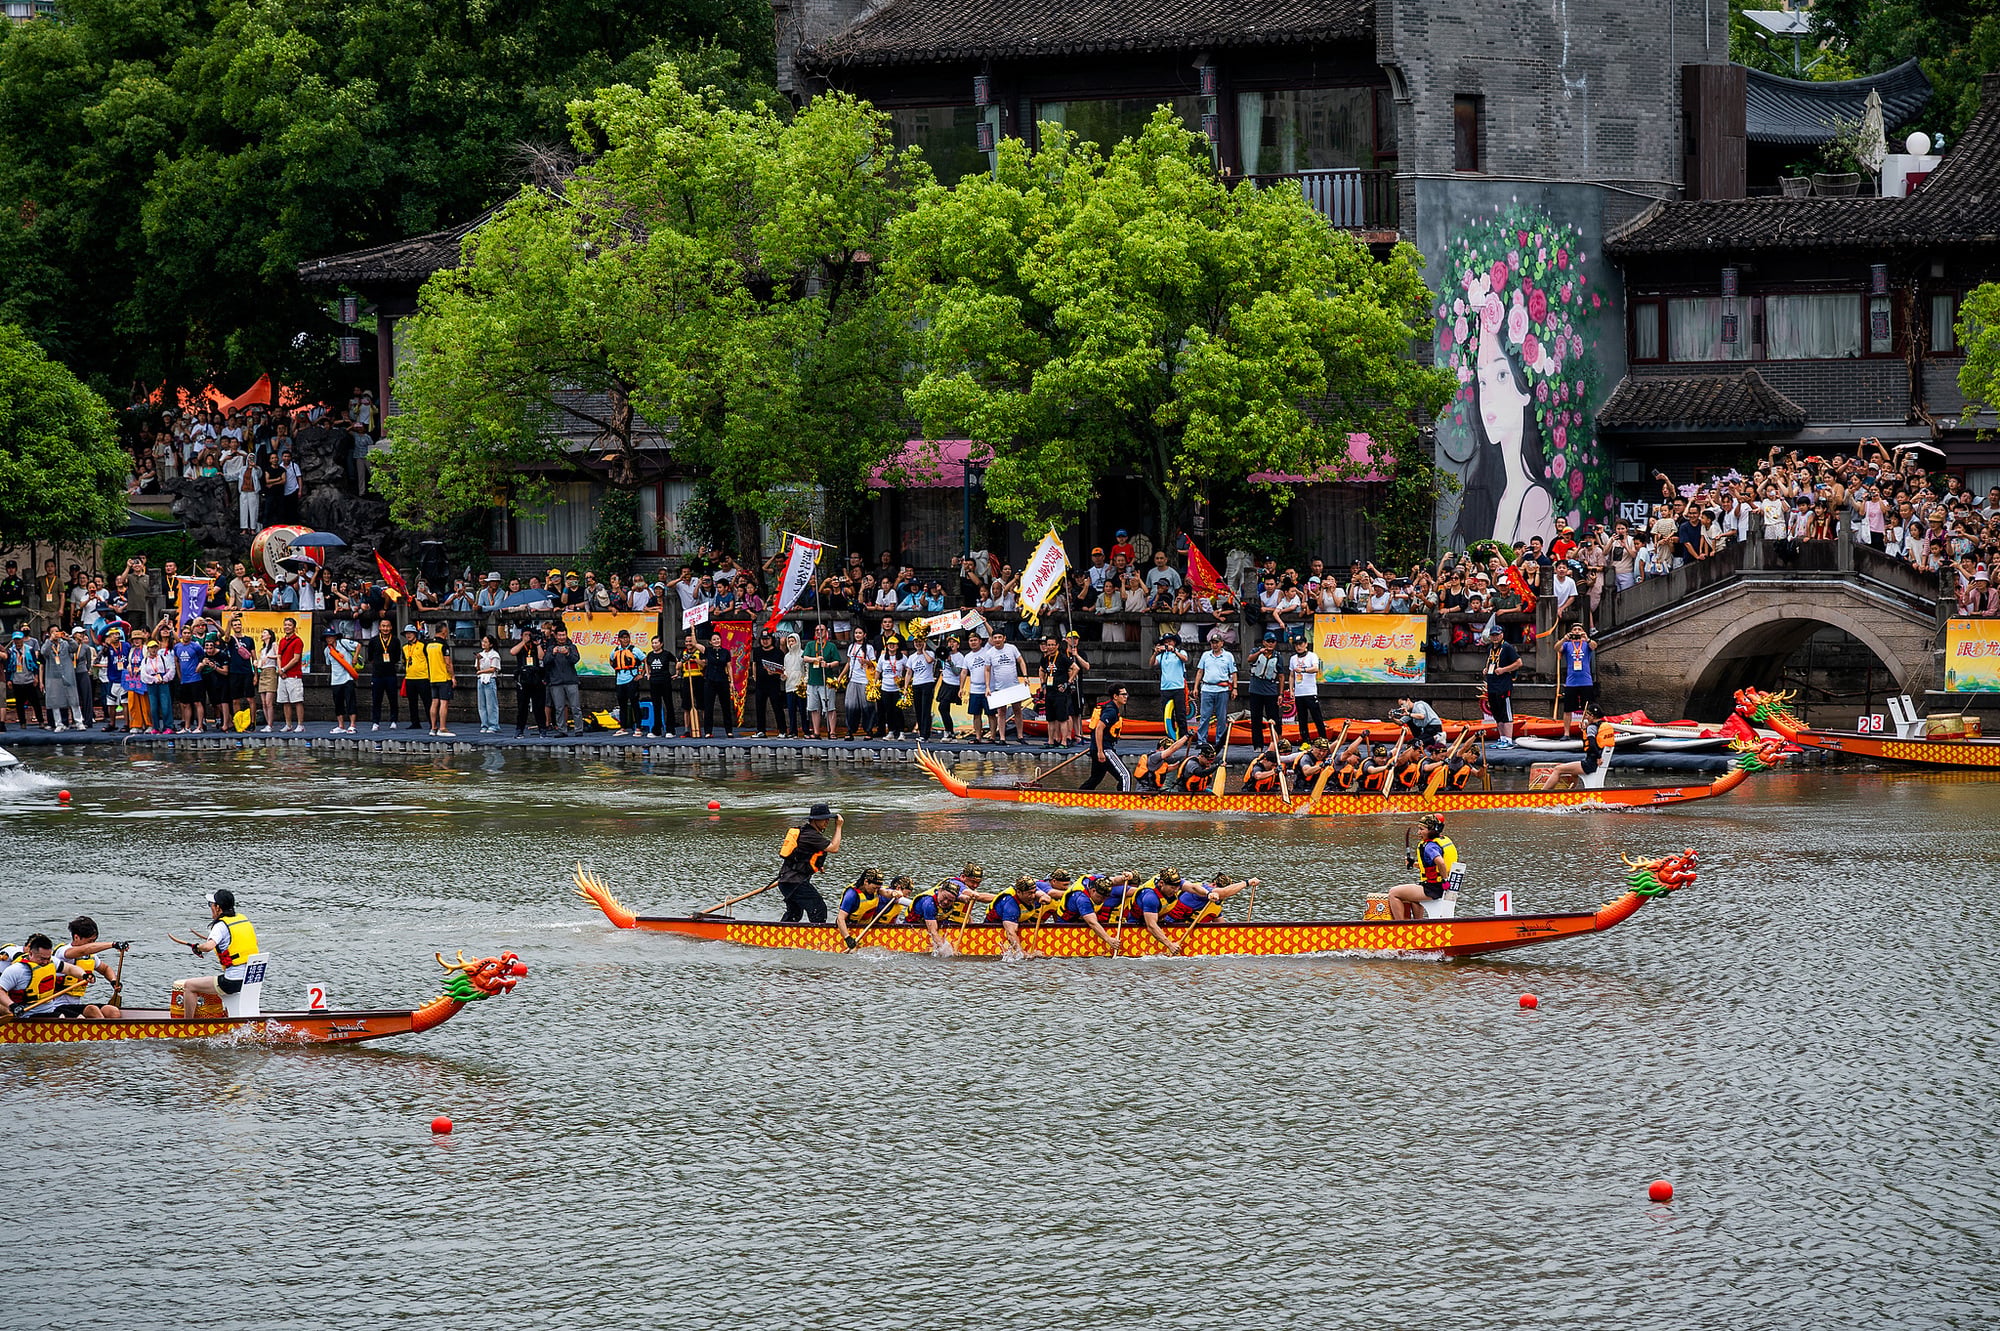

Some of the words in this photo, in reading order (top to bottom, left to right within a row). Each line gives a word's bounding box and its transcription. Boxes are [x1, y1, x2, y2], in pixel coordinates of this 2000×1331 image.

[1323, 633, 1416, 650] 跟着龙舟走大运
[1957, 641, 2000, 658] 跟着龙
[1499, 893, 1508, 912] 1
[310, 988, 325, 1009] 2
